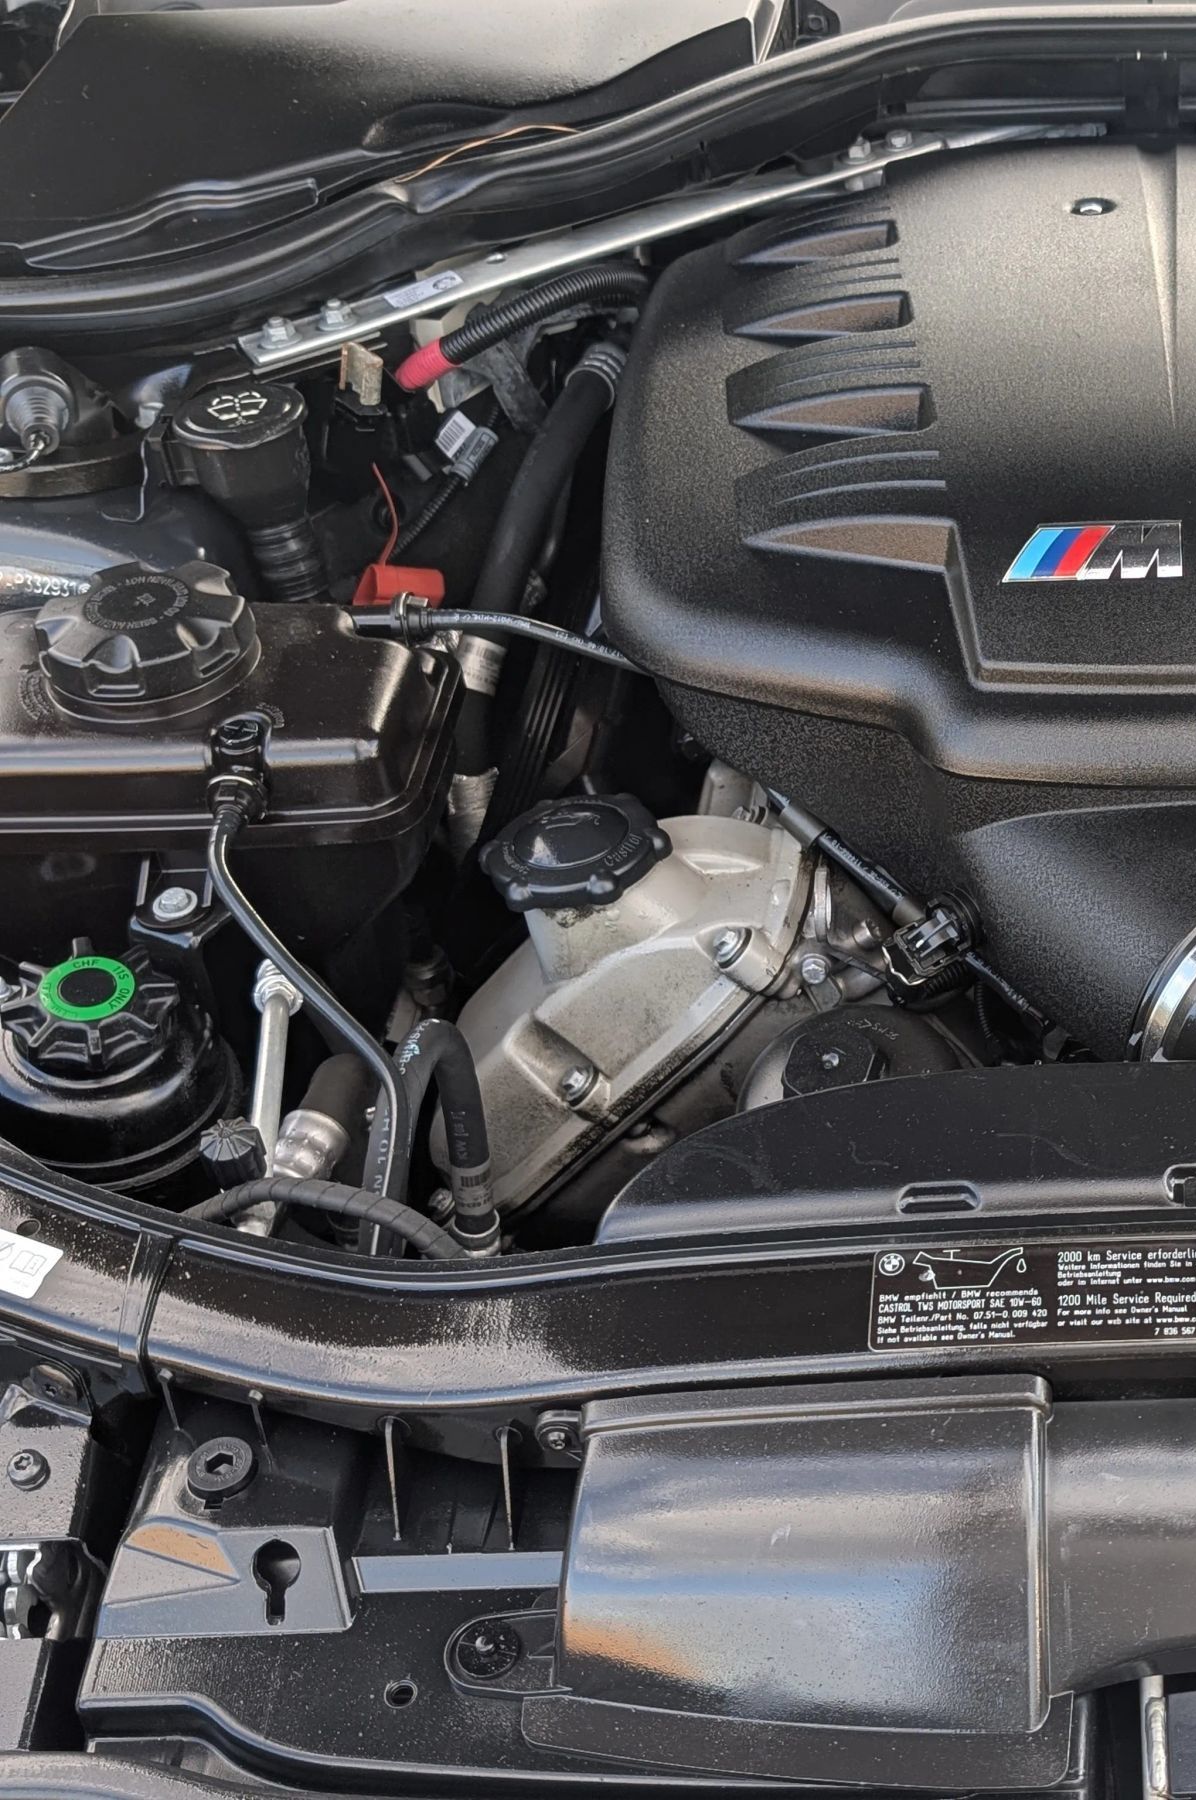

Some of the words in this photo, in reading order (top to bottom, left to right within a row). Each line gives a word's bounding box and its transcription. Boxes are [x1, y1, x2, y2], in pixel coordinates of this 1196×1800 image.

[73, 959, 101, 969] CHF
[113, 965, 130, 980] 11S
[109, 988, 130, 1010] ONLY
[1057, 1251, 1082, 1263] 2000
[1087, 1251, 1101, 1262] km
[1106, 1249, 1142, 1260] Service
[1058, 1263, 1086, 1271] Weitere
[1090, 1262, 1140, 1270] Informationen
[1144, 1260, 1167, 1268] finden
[1169, 1260, 1181, 1268] Sie
[1057, 1270, 1122, 1279] Betriebsanleitung
[1057, 1279, 1074, 1287] oder
[1090, 1277, 1120, 1285] Internet
[1146, 1275, 1196, 1284] www.bmw.com
[879, 1294, 900, 1302] BMW
[903, 1292, 947, 1301] empfiehlt
[951, 1291, 957, 1299] /
[960, 1290, 981, 1298] BMW
[985, 1288, 1038, 1297] recommends
[1058, 1294, 1081, 1306] 1200
[1086, 1293, 1107, 1305] Mile
[1113, 1292, 1150, 1304] Service
[878, 1302, 913, 1313] CASTROL
[917, 1301, 934, 1311] TWS
[937, 1299, 985, 1311] MOTORSPORT
[989, 1298, 1005, 1307] SAE
[1010, 1296, 1042, 1307] 10W-60
[1057, 1308, 1070, 1316] For
[1095, 1307, 1111, 1315] info
[1130, 1305, 1159, 1314] Owner's
[1162, 1304, 1188, 1313] Manual
[877, 1315, 896, 1325] BMW
[956, 1312, 969, 1321] No.
[1012, 1309, 1028, 1318] 009
[1032, 1308, 1048, 1317] 420
[876, 1325, 897, 1335] Siehe
[969, 1322, 988, 1330] falls
[990, 1321, 1010, 1329] nicht
[1013, 1319, 1048, 1329] verfügbar
[1154, 1328, 1160, 1336] 7
[1181, 1326, 1196, 1335] 567
[876, 1336, 884, 1344] If
[887, 1335, 900, 1343] not
[903, 1334, 938, 1342] available
[957, 1331, 986, 1340] Owner's
[988, 1330, 1016, 1338] Manual.
